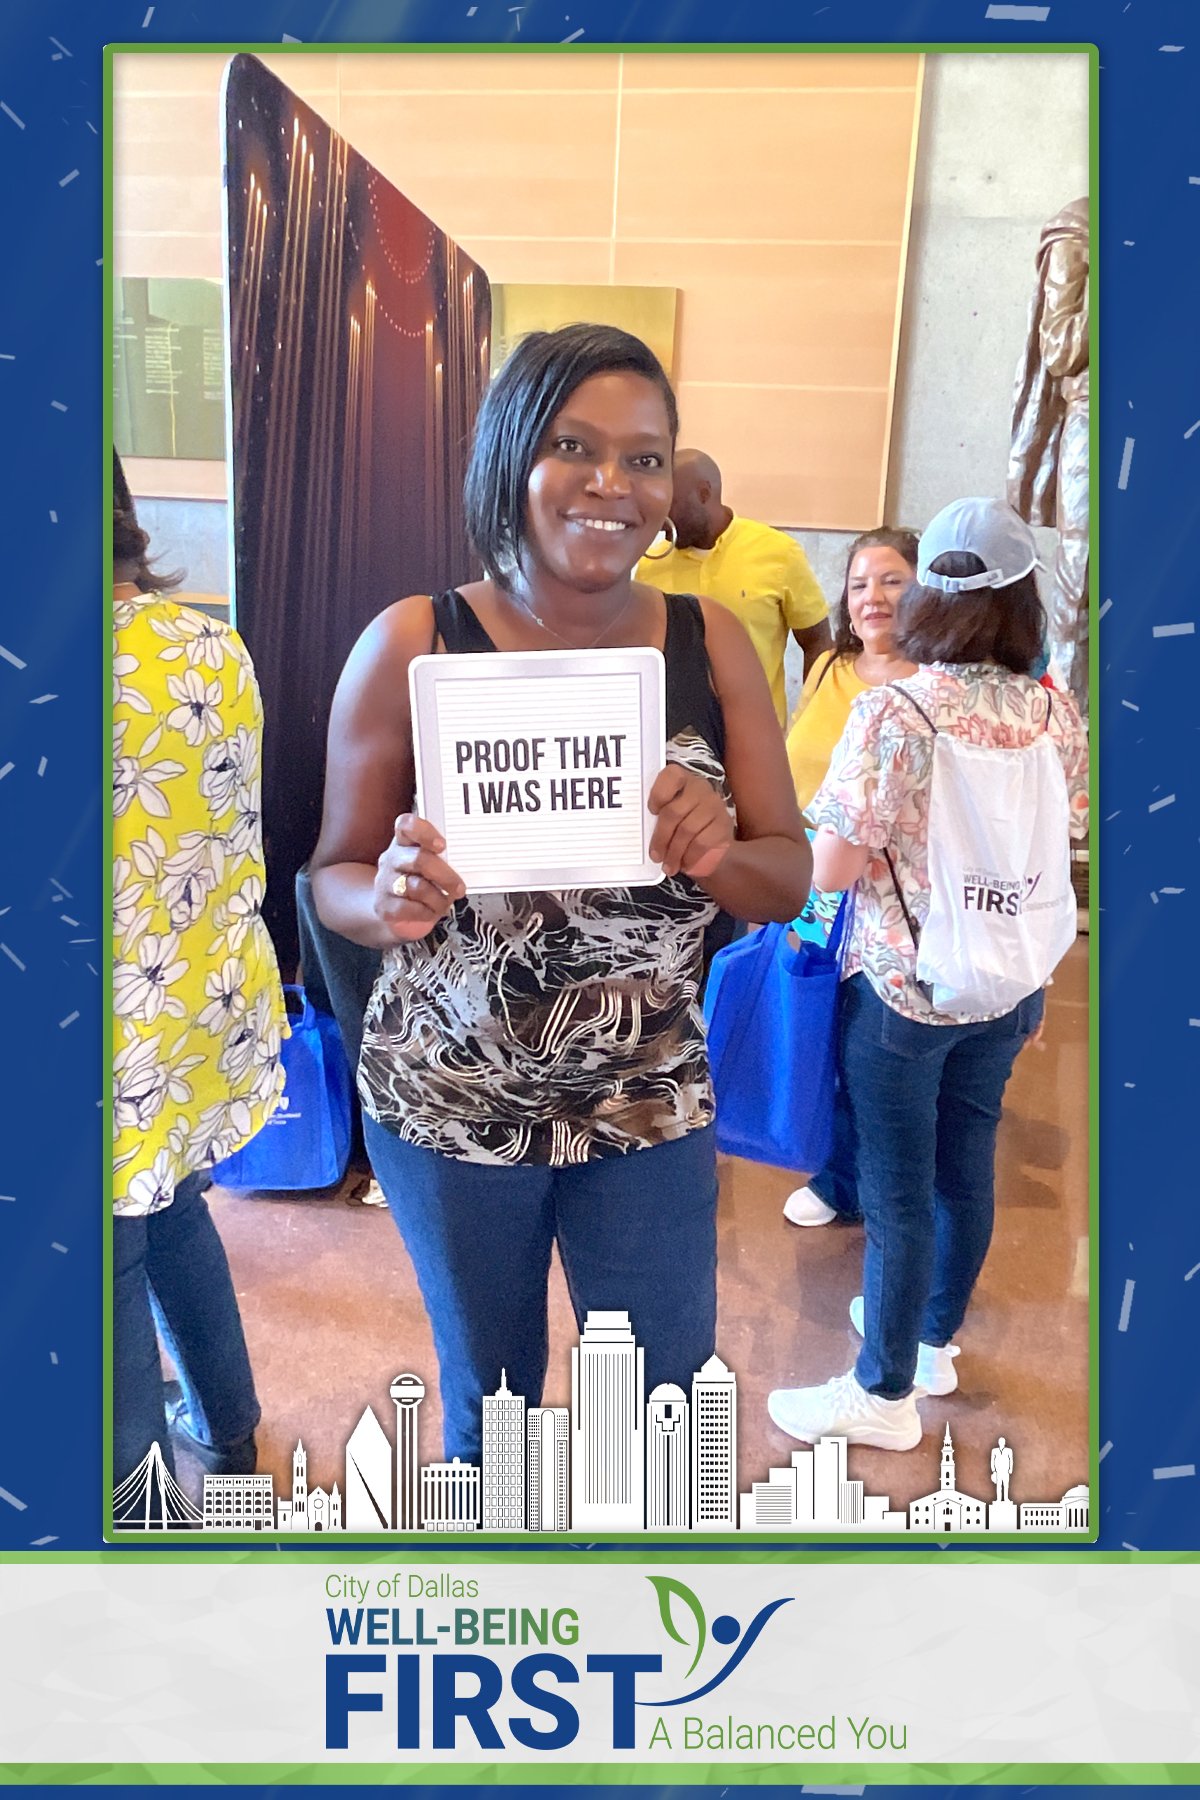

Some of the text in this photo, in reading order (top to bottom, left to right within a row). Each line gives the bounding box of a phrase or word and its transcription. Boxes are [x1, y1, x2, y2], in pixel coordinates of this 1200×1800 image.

[456, 734, 627, 774] PROOF THAT
[462, 776, 623, 815] I WAS HERE
[963, 873, 1021, 891] WELL-BEING
